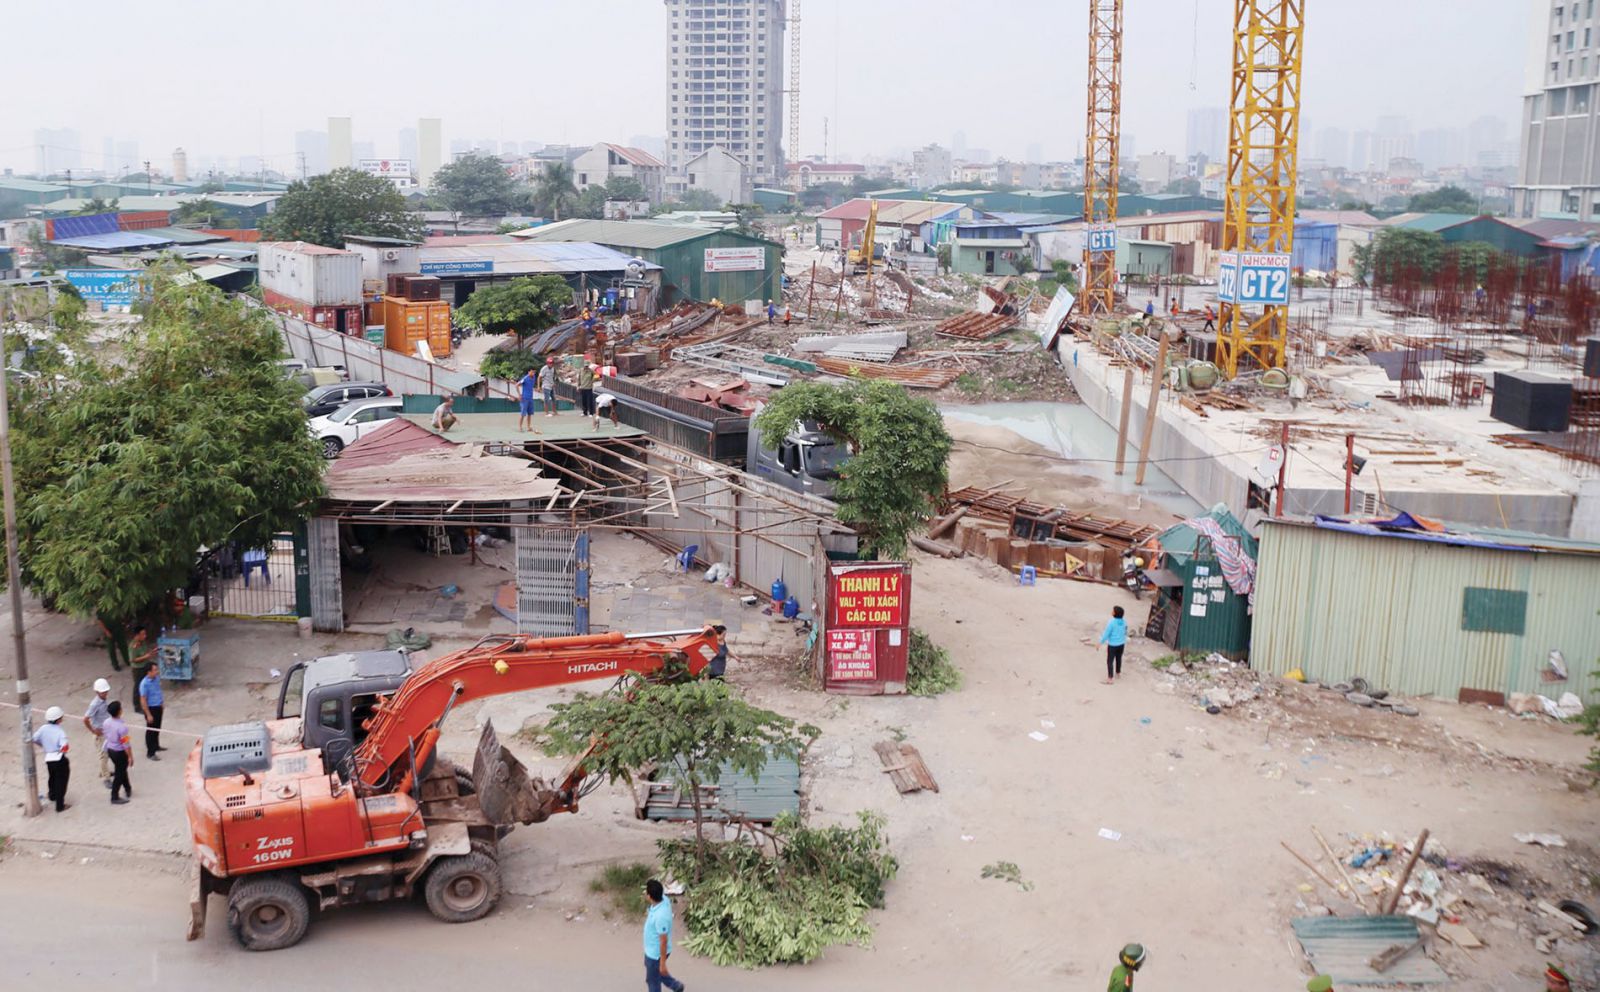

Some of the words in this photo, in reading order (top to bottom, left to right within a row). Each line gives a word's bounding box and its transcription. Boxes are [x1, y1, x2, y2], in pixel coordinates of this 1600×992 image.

[1091, 231, 1114, 248] CT1
[1220, 268, 1235, 297] CT2
[1241, 268, 1286, 298] CT2
[840, 577, 880, 592] THANH
[884, 574, 898, 592] LÝ
[839, 596, 856, 607] VALI
[863, 594, 876, 607] TÚI
[877, 594, 898, 607] XÁCH
[846, 609, 866, 621] CÁC
[869, 611, 891, 624] LOẠI
[568, 661, 618, 674] HITACHI
[256, 836, 294, 850] ZAXIS
[252, 848, 293, 863] 160W
